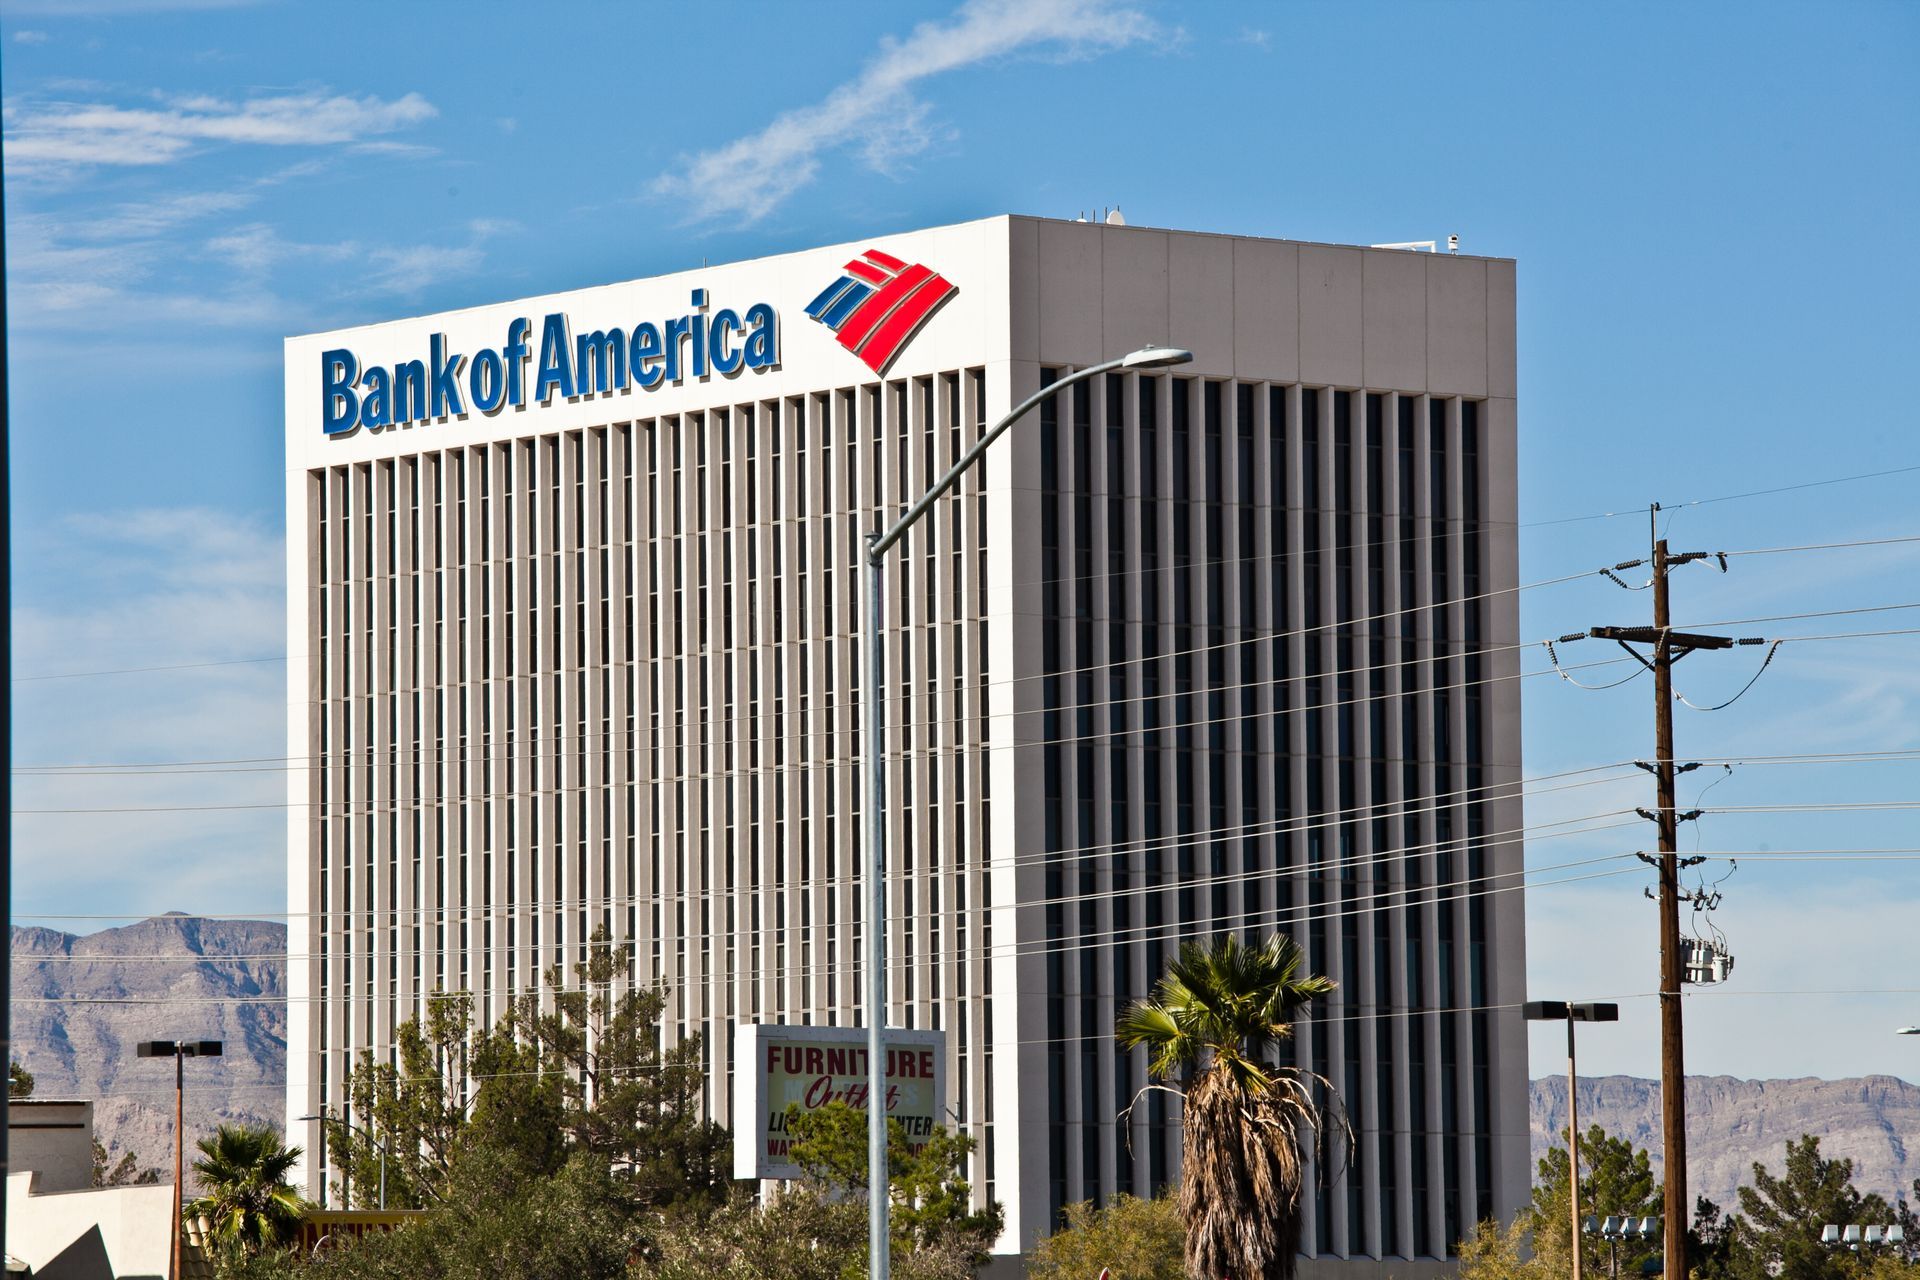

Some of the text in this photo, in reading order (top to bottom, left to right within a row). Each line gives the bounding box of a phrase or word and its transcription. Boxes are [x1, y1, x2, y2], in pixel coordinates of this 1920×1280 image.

[322, 287, 781, 435] Bank of America
[804, 1075, 901, 1111] Outlt
